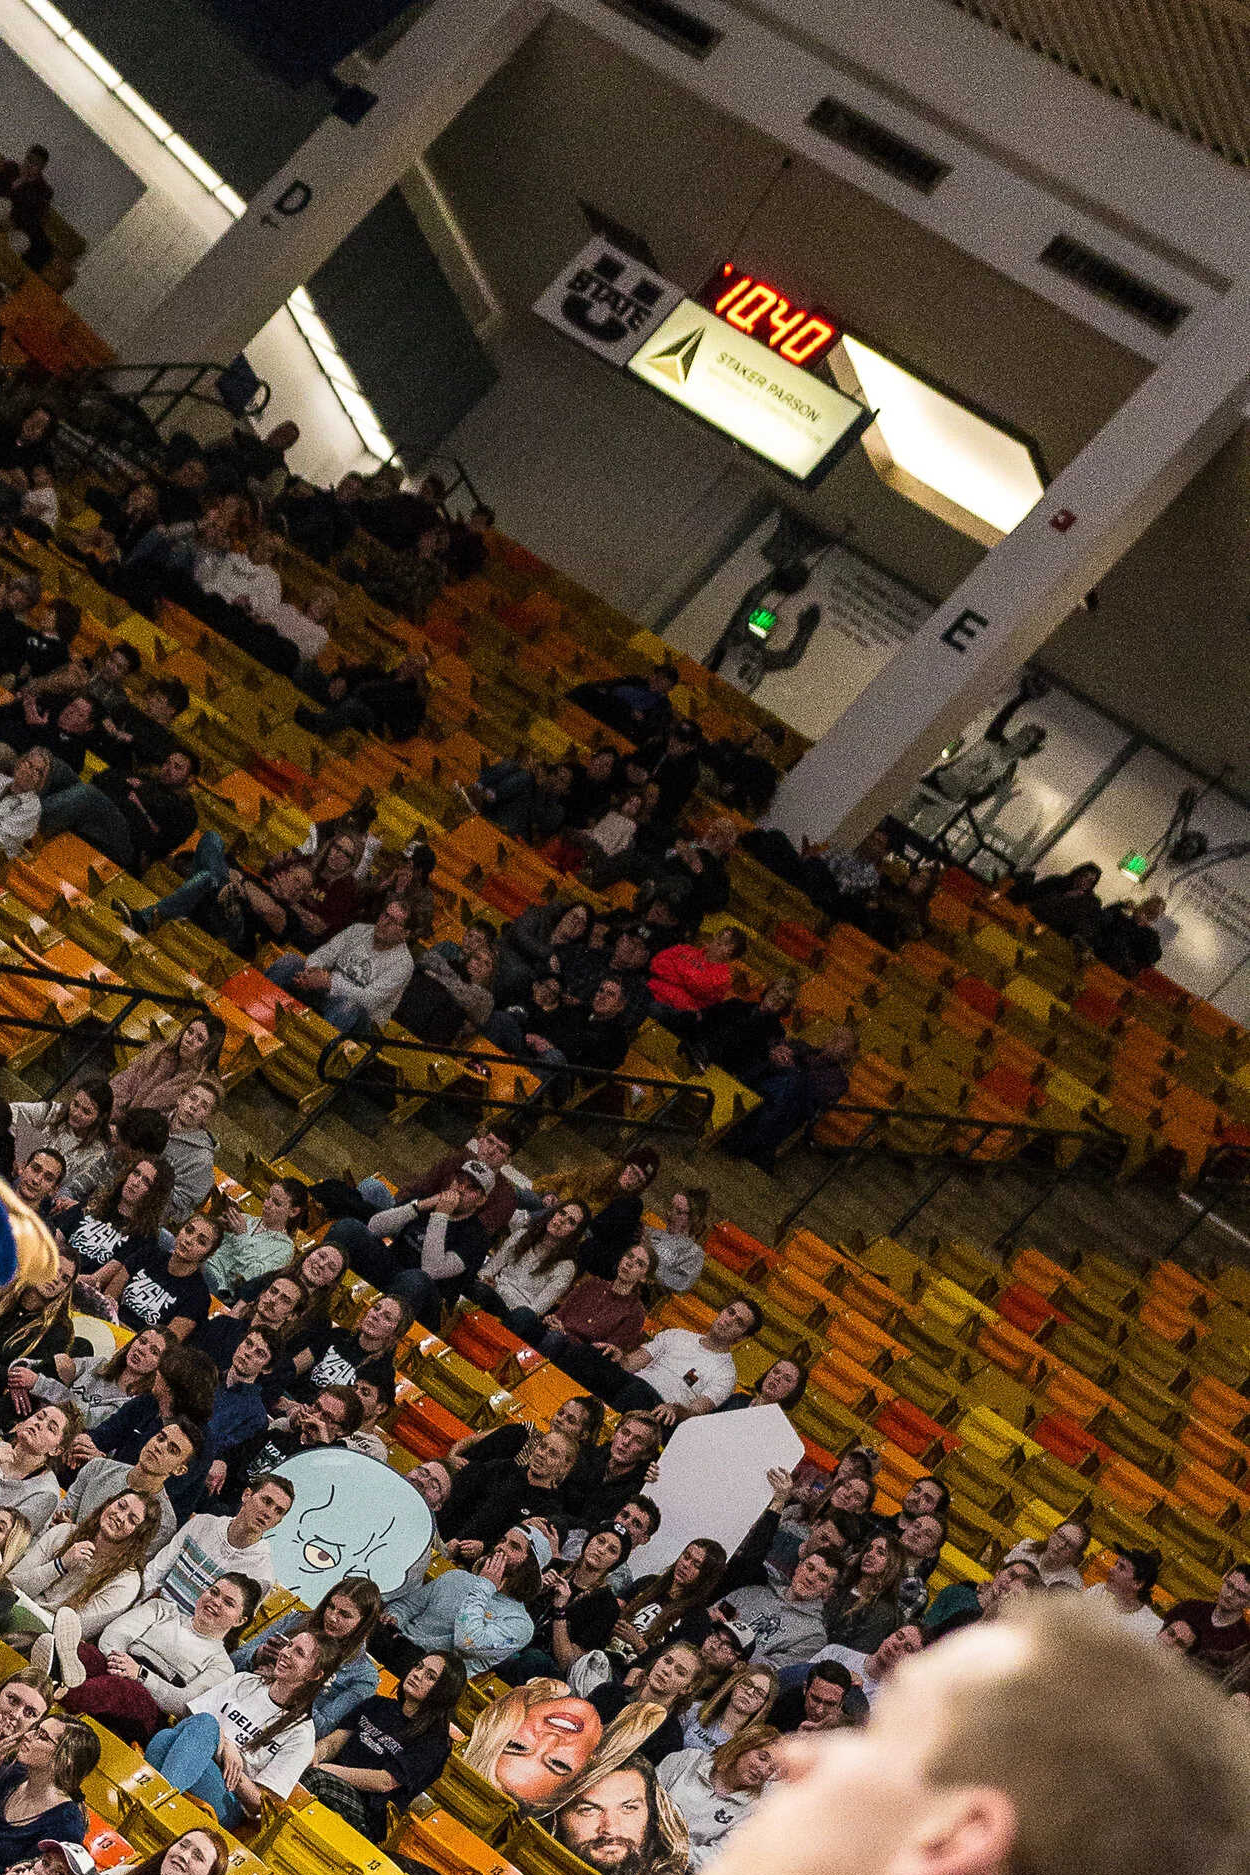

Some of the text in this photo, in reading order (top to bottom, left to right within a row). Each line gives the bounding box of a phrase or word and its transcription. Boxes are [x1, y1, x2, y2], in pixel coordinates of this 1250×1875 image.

[273, 180, 312, 216] D
[716, 352, 821, 423] STAKER PARSON
[941, 608, 990, 654] E
[227, 1708, 282, 1756] BELIEE
[366, 1859, 382, 1871] 13
